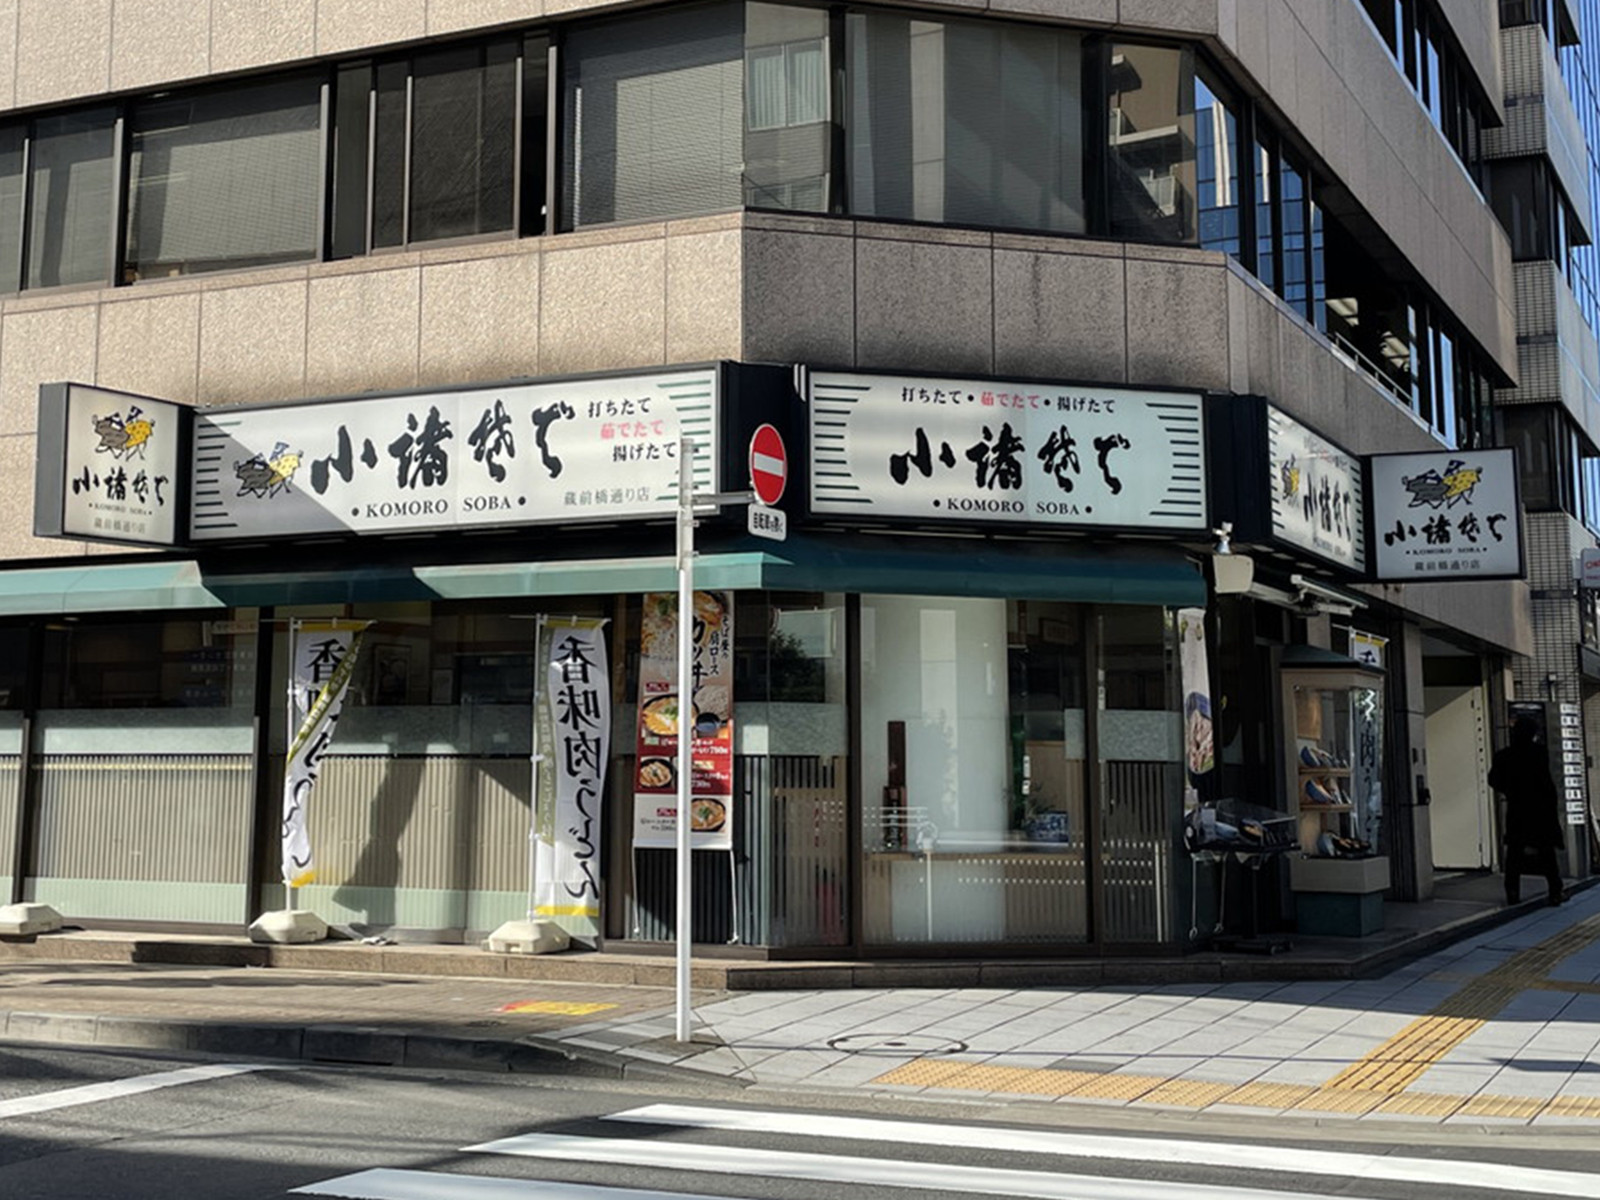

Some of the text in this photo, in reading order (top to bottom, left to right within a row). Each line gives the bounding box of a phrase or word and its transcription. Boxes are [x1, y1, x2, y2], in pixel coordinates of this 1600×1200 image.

[588, 397, 651, 418] 打ちたて
[902, 387, 962, 405] 打ちたて
[1057, 396, 1115, 414] 揚げたて
[613, 442, 676, 462] 揚げたて
[366, 496, 511, 518] KOMORO SOBA
[947, 497, 1080, 516] KOMORO SOBA
